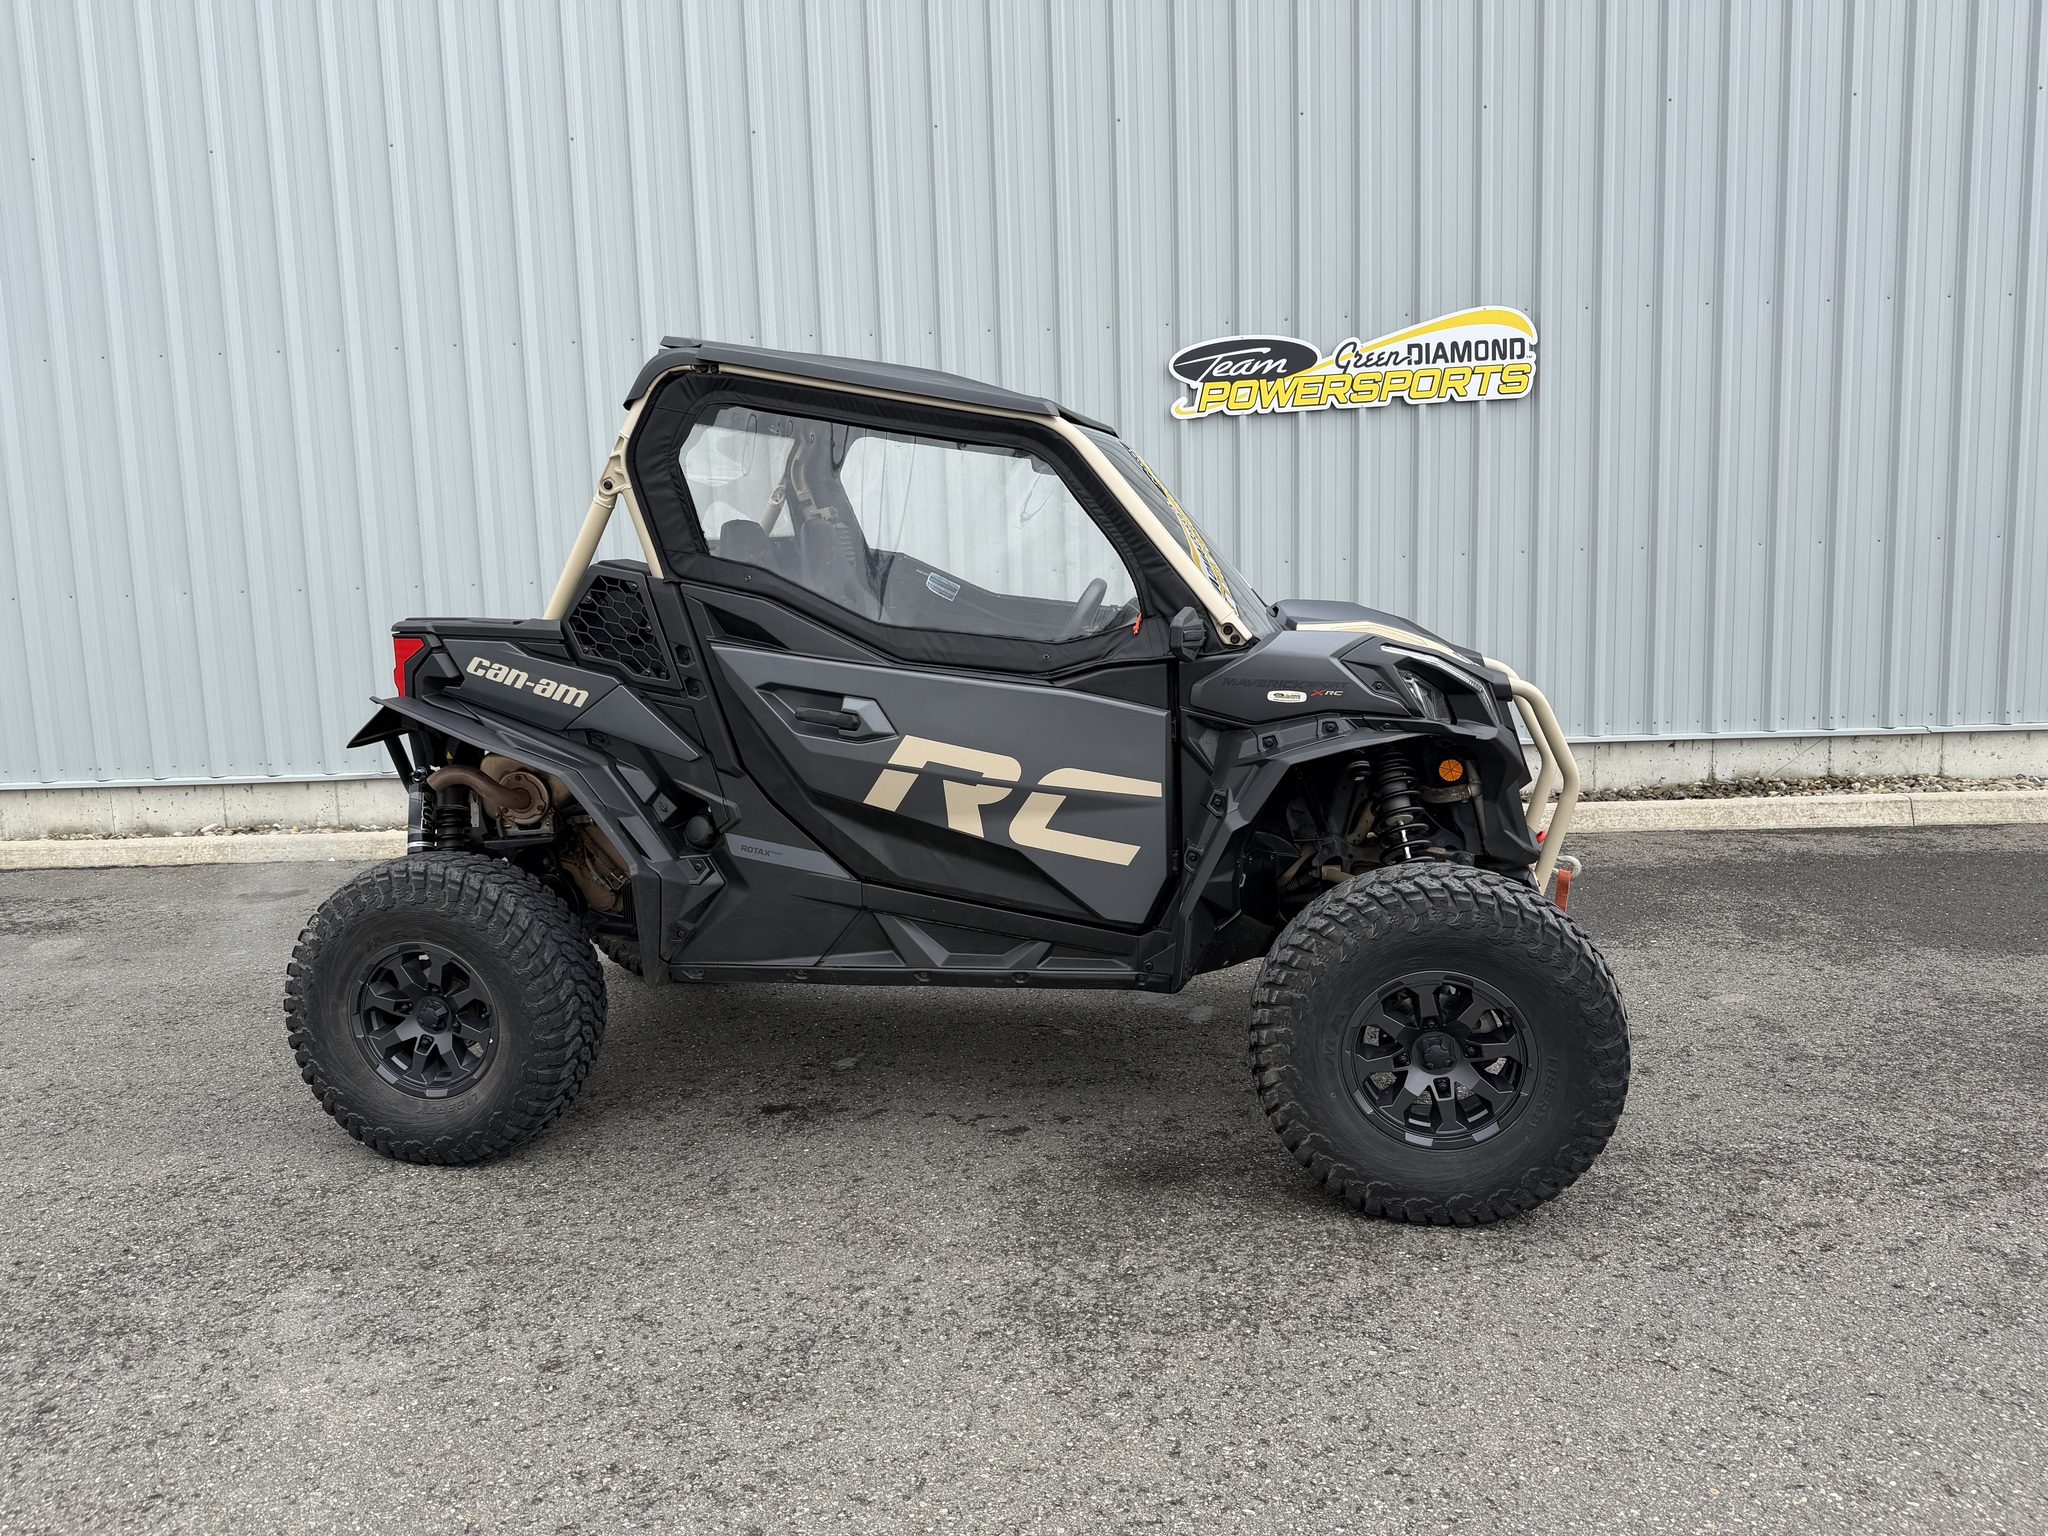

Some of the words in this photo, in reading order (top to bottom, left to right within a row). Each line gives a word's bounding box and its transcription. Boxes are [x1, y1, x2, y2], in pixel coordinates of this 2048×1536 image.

[1174, 347, 1288, 382] Team
[1335, 341, 1412, 375] Green
[1407, 337, 1527, 366] DIAMOND
[1197, 363, 1532, 412] POWERSPORTS
[466, 656, 589, 708] can-am
[1221, 677, 1305, 689] MAVERICK
[862, 734, 1163, 867] RC
[741, 844, 771, 857] ROTAX
